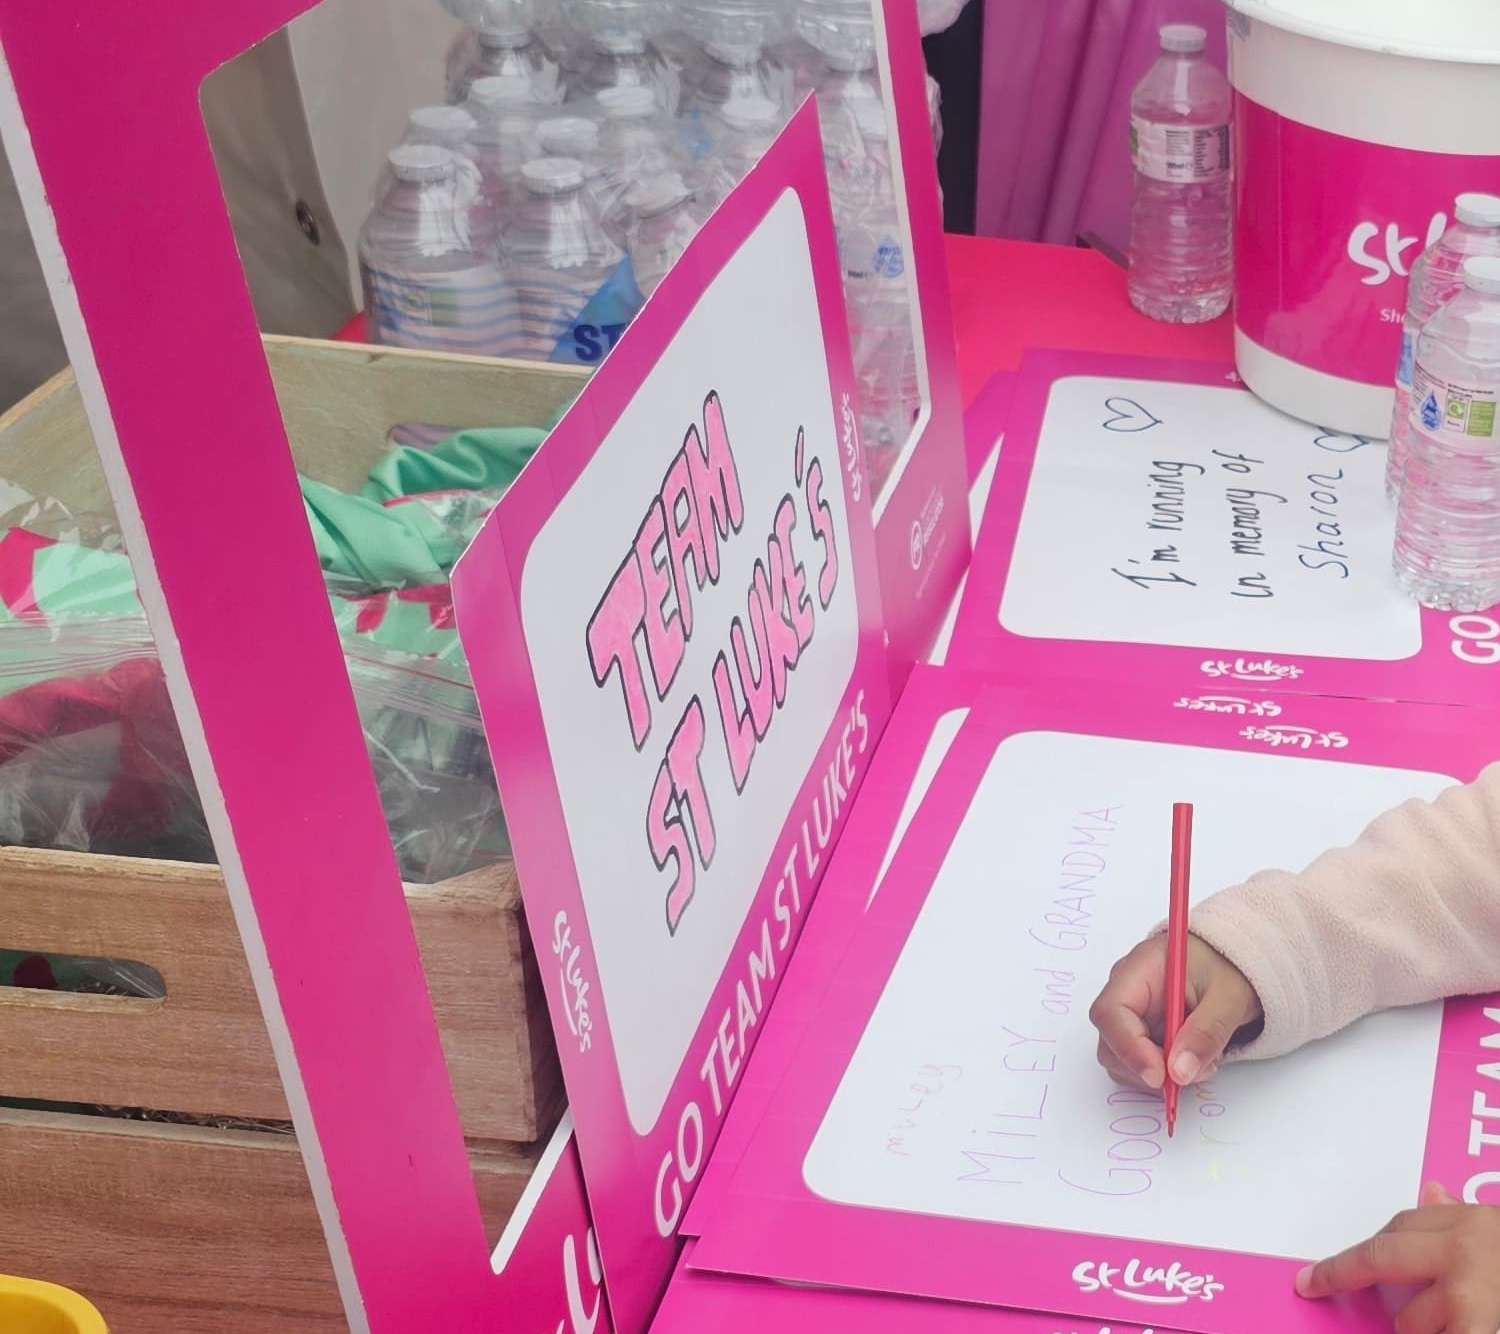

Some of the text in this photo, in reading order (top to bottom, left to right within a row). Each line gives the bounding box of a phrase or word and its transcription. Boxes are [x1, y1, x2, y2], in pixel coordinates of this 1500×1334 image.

[1346, 221, 1419, 287] St
[1211, 448, 1265, 474] of
[1111, 460, 1206, 590] I'm running
[1229, 487, 1289, 557] memory
[1296, 467, 1350, 579] Sharon
[585, 388, 744, 753] TEAM
[645, 424, 838, 936] ST LUKE'S
[1200, 657, 1305, 680] St Luke's
[1238, 724, 1350, 749] St Luke's
[1250, 700, 1283, 718] St
[1028, 804, 1124, 952] GRANDMA
[653, 689, 870, 1239] GO TEAM ST LUKE'S
[1034, 968, 1078, 1016] and
[1071, 1257, 1226, 1303] St Luke's
